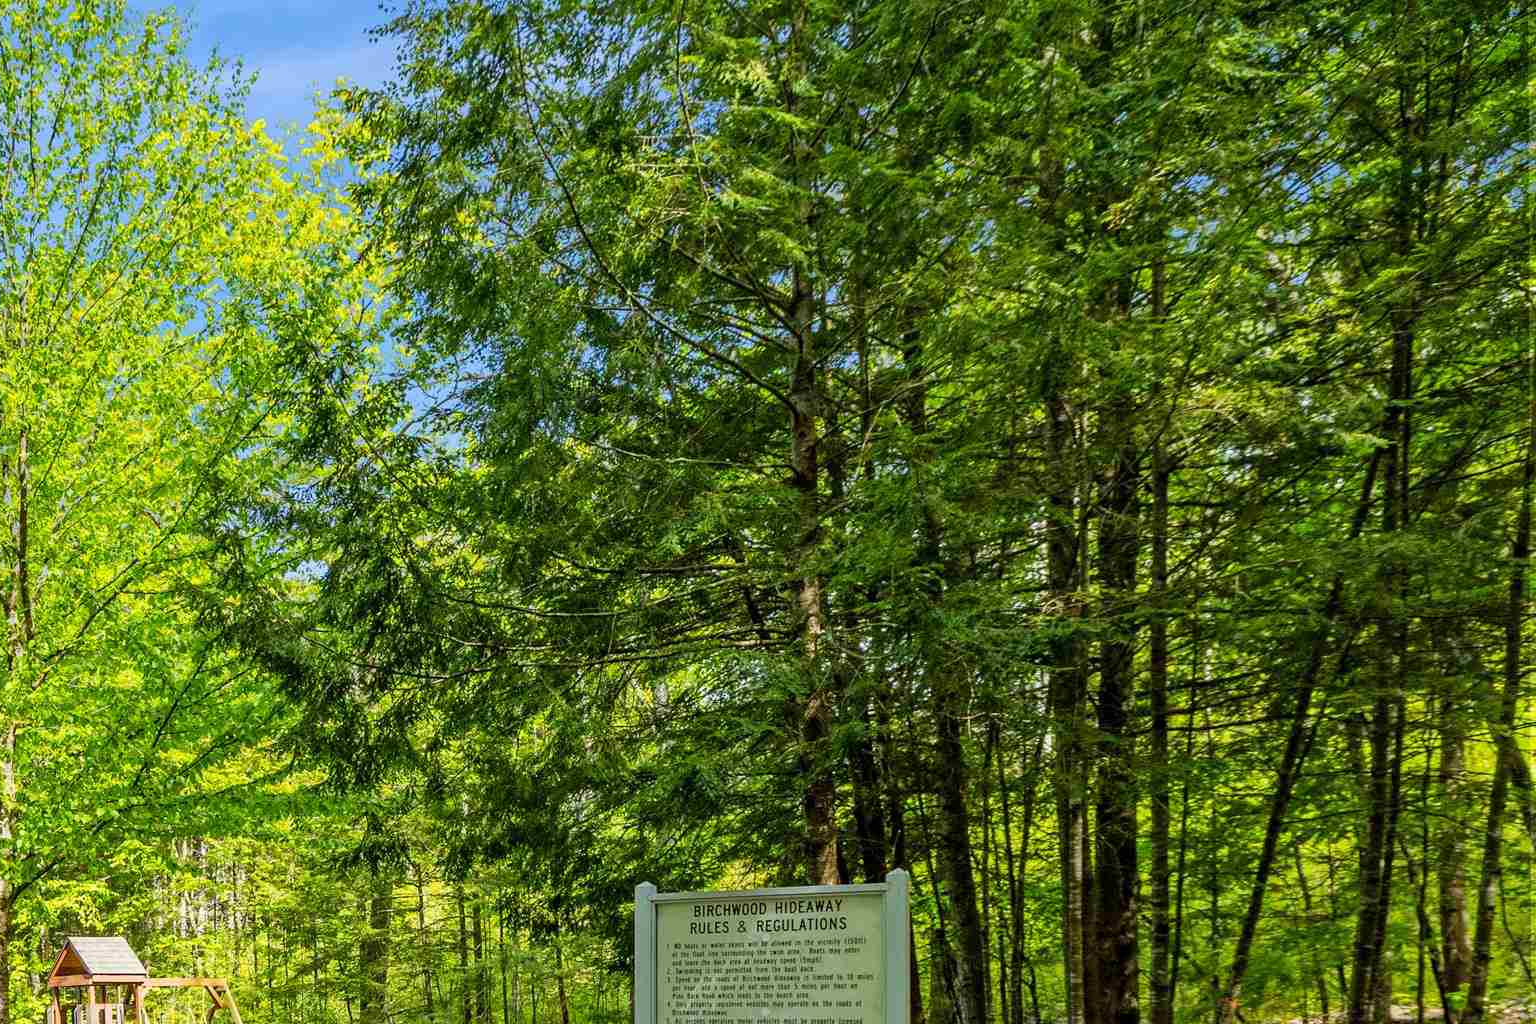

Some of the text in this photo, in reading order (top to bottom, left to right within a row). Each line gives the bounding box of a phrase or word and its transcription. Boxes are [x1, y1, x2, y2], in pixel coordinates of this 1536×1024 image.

[694, 899, 843, 917] BIRCHWOOD HIDEAWAY
[690, 916, 848, 935] RULES & REGULATIONS
